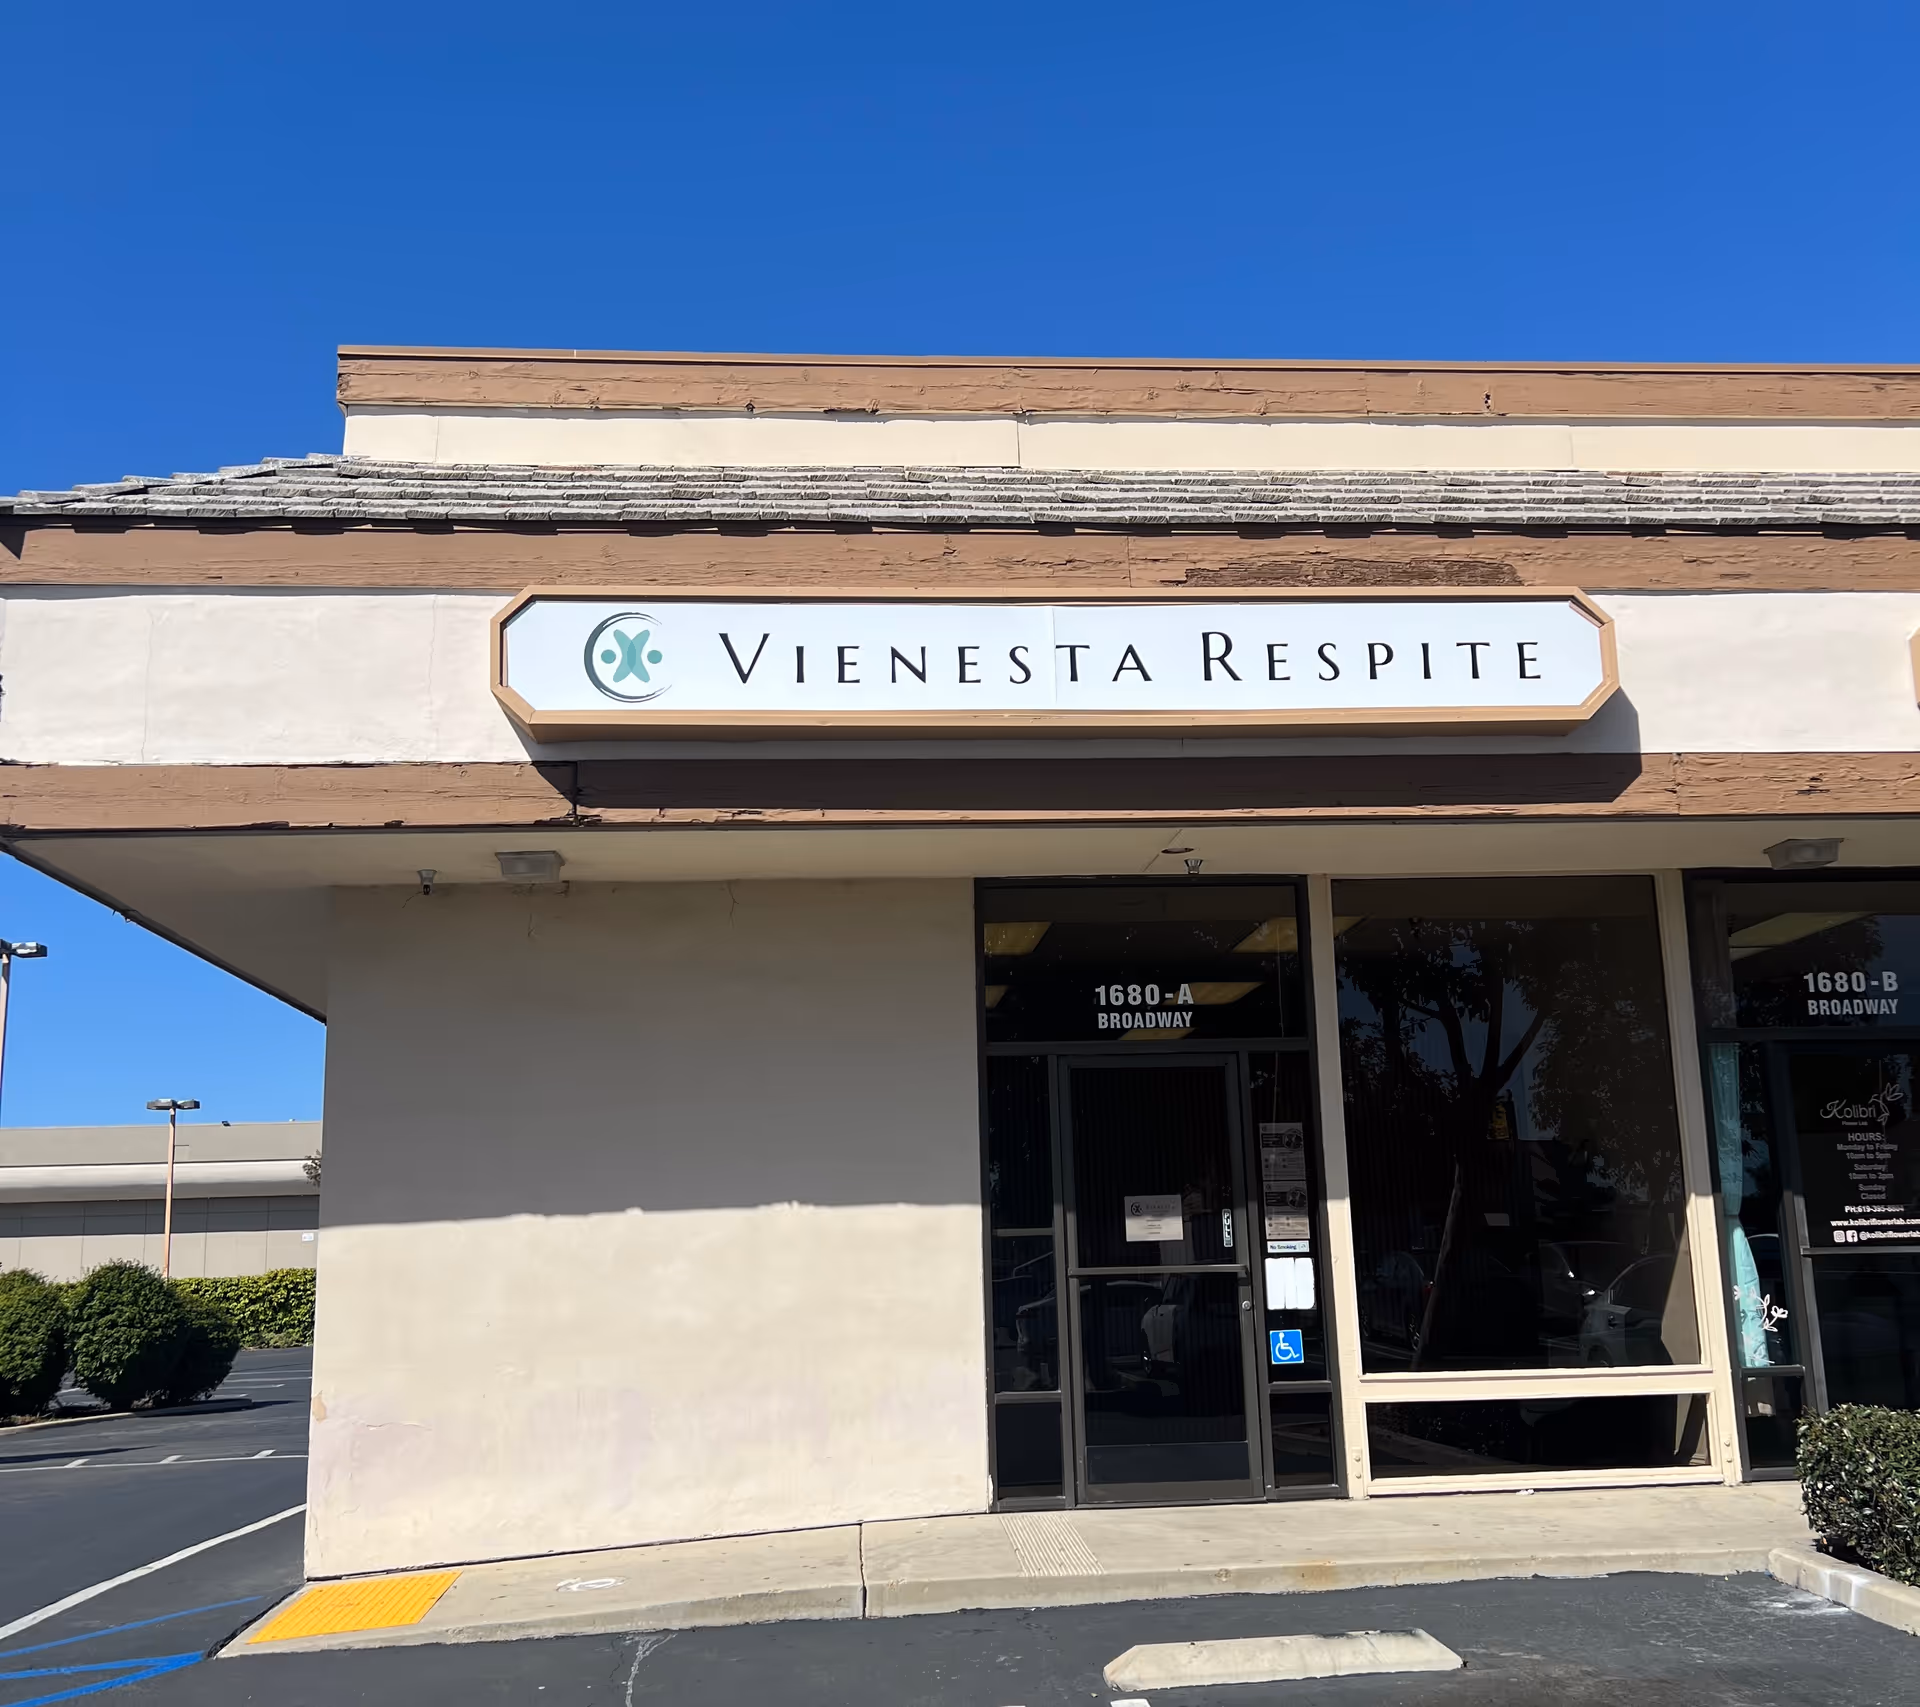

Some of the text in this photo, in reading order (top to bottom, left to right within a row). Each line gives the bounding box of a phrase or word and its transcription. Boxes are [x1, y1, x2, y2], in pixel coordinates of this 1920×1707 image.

[1803, 971, 1899, 993] 1680-B
[1094, 983, 1194, 1006] 1680-A
[1807, 998, 1899, 1016] BROADWAY
[1097, 1011, 1193, 1030] BROADWAY
[1819, 1098, 1877, 1119] Kolibri
[1836, 1143, 1865, 1152] Monday
[1875, 1143, 1899, 1151] Friday
[1846, 1152, 1866, 1160] 10am
[1858, 1183, 1887, 1192] Sunday
[1860, 1192, 1887, 1200] Closed
[1223, 1212, 1232, 1238] PULL
[1276, 1243, 1297, 1251] Smoking
